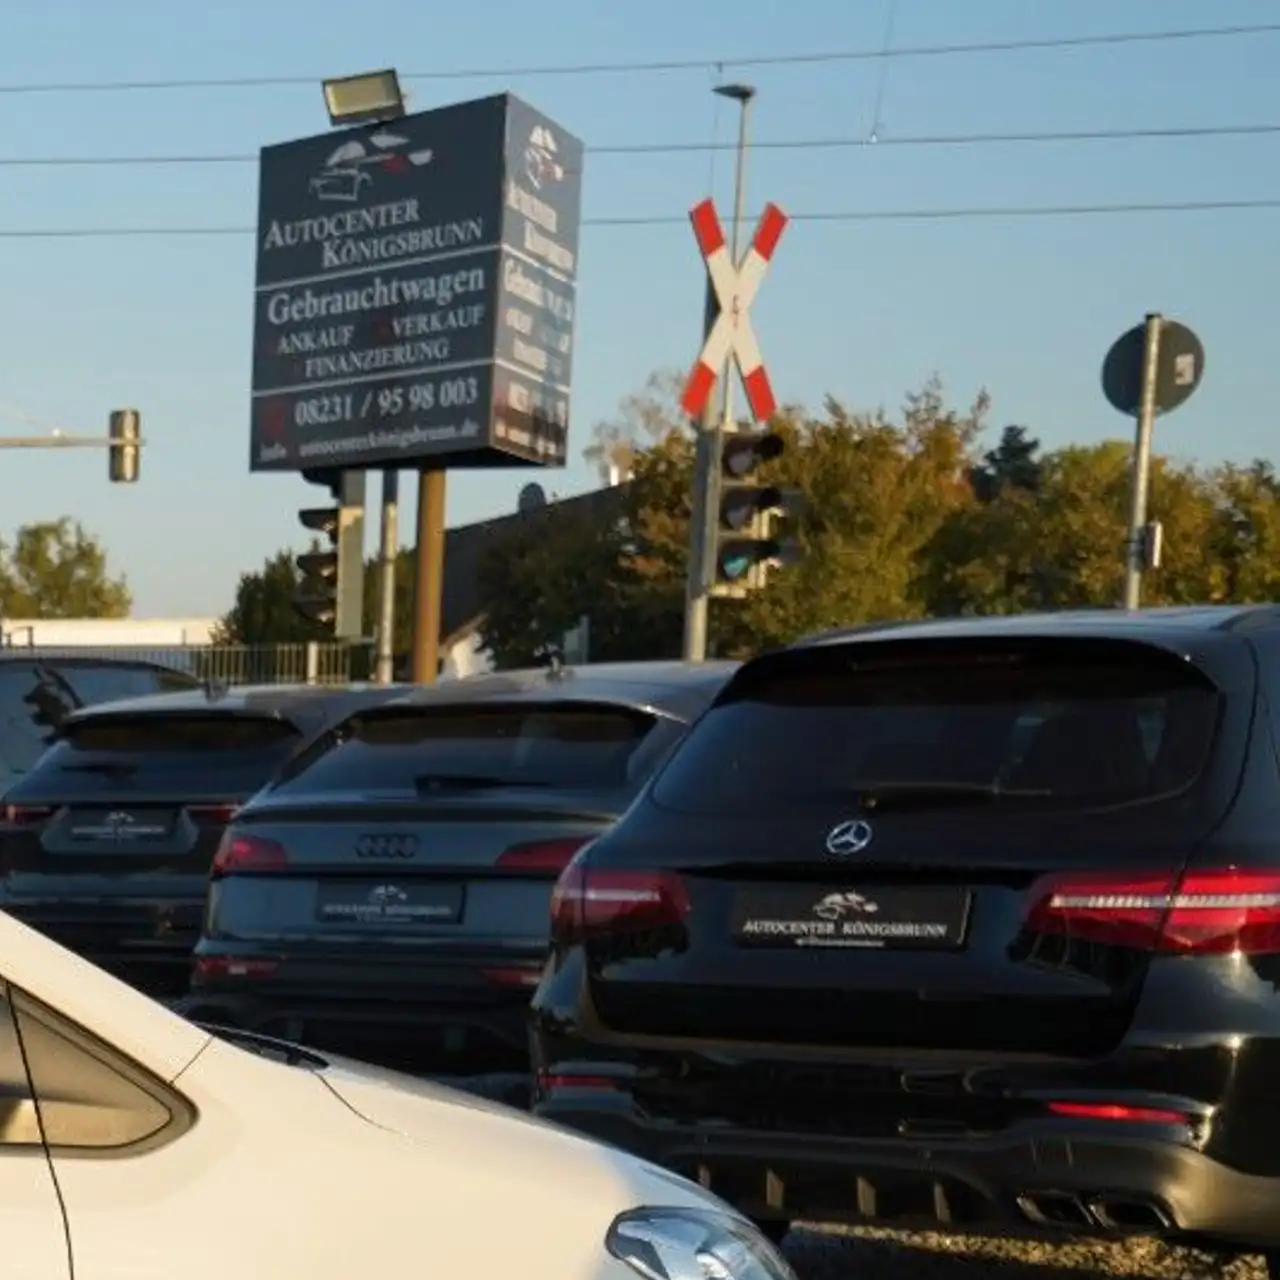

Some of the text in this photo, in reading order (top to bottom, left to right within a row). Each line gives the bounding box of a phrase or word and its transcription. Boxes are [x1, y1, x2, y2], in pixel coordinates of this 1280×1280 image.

[263, 199, 420, 250] AUTOCENTER
[321, 217, 484, 270] KÖNIGSBRUNN
[267, 267, 485, 325] Gebrauchtwagen
[277, 325, 355, 355] ANKAUF
[391, 304, 486, 337] VERKAUF
[304, 340, 450, 378] FINANZIERUNG
[742, 918, 836, 936] AUTOCENTER
